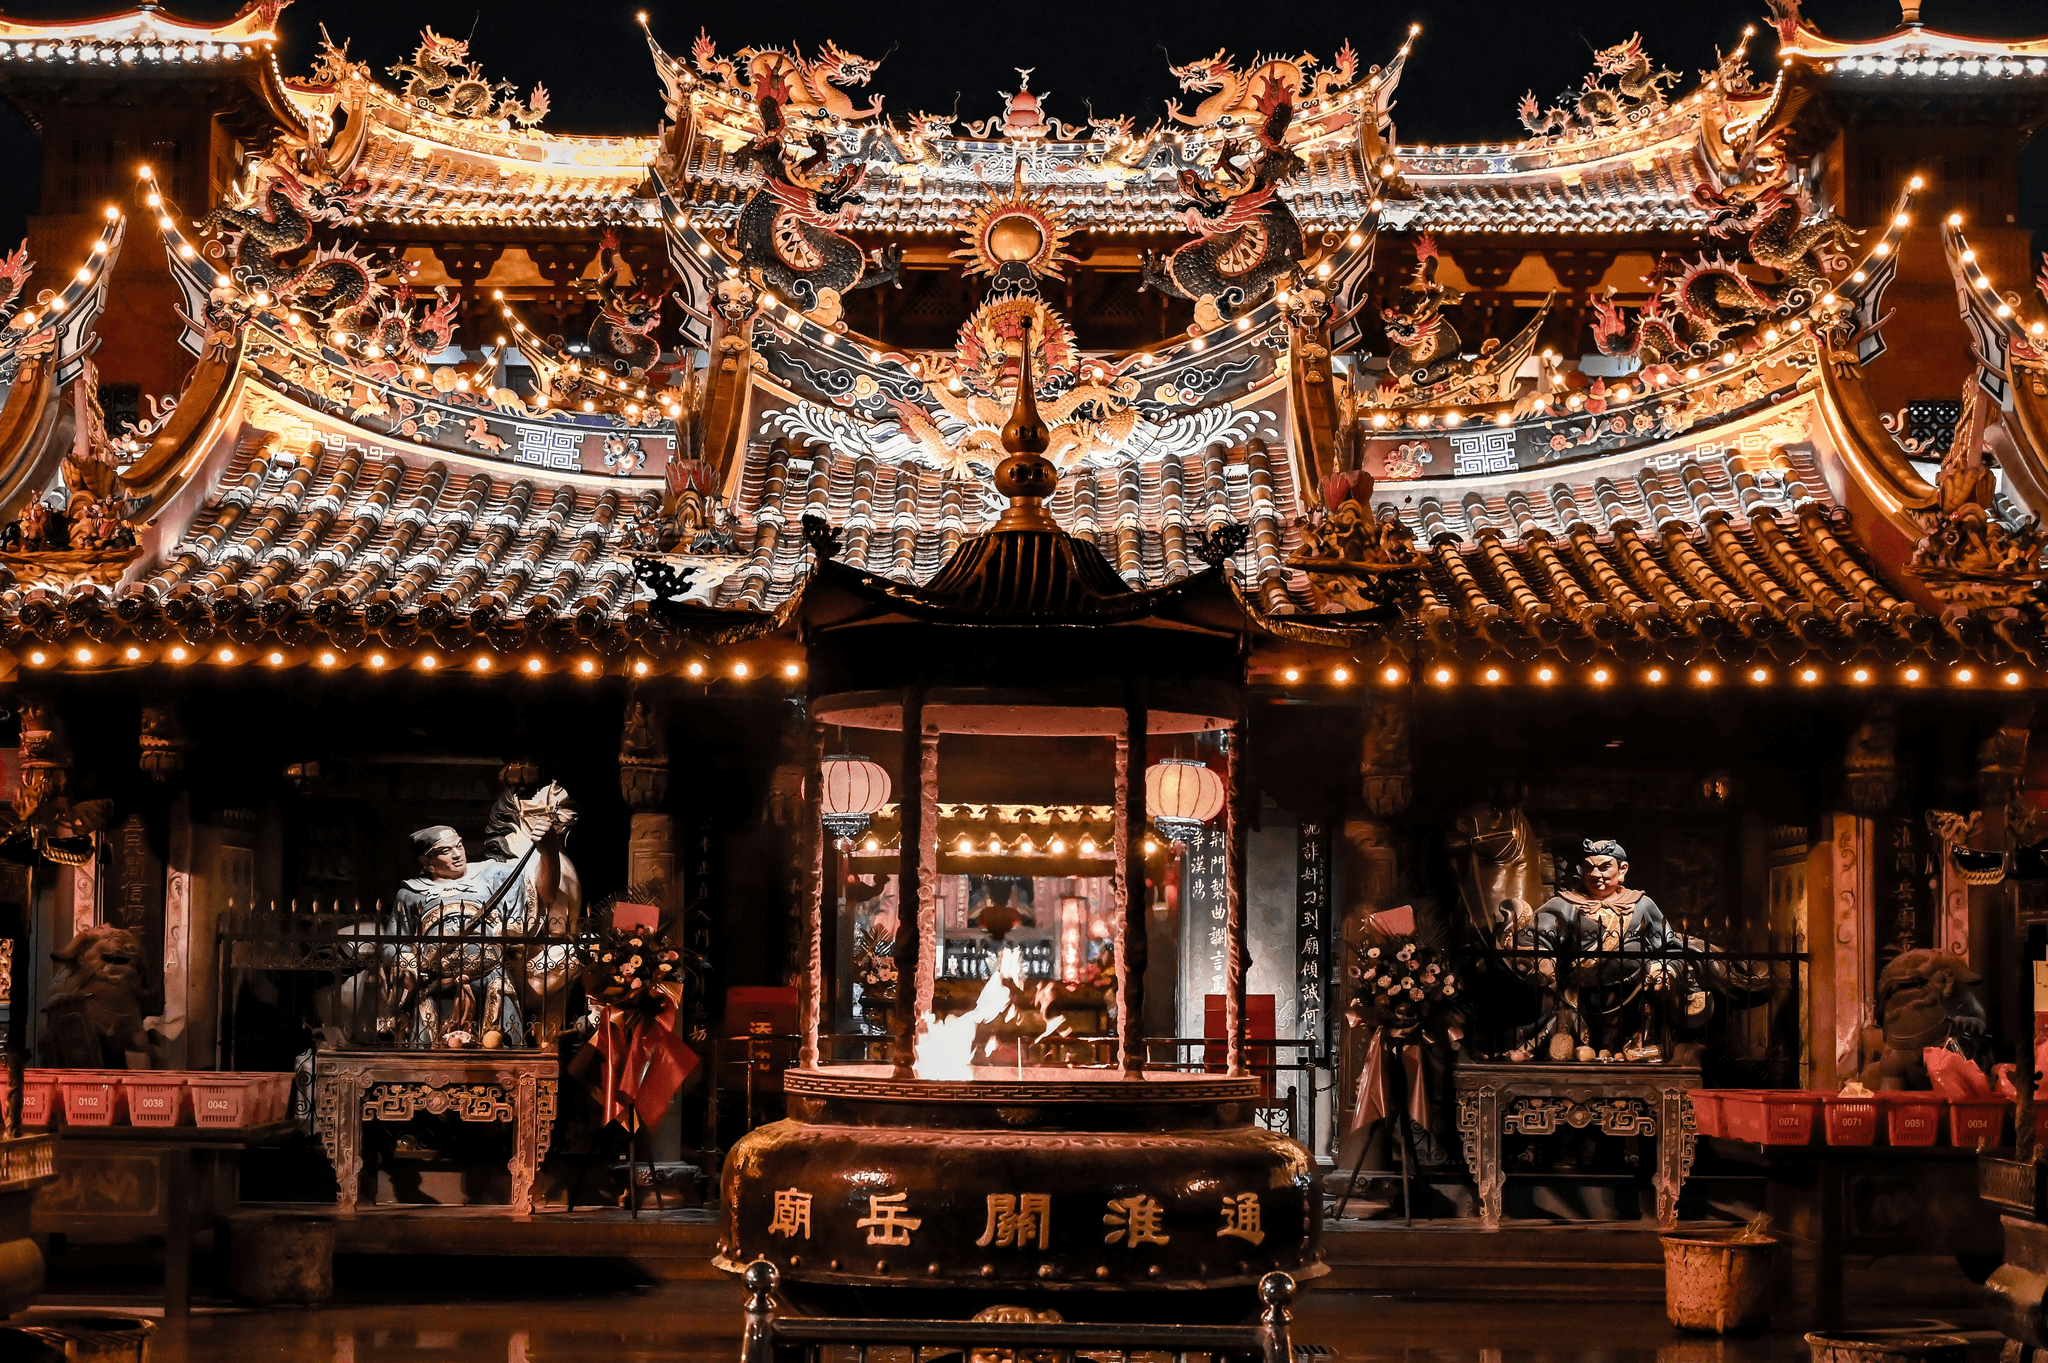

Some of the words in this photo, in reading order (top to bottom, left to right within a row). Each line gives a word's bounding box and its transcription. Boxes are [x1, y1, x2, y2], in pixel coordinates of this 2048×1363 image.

[79, 1097, 99, 1106] 0102
[143, 1099, 164, 1108] 0038
[207, 1100, 228, 1109] 0042
[1779, 1117, 1799, 1126] 0074
[1842, 1118, 1862, 1127] 0071
[1904, 1119, 1925, 1128] 0051
[1968, 1120, 1987, 1128] 0034
